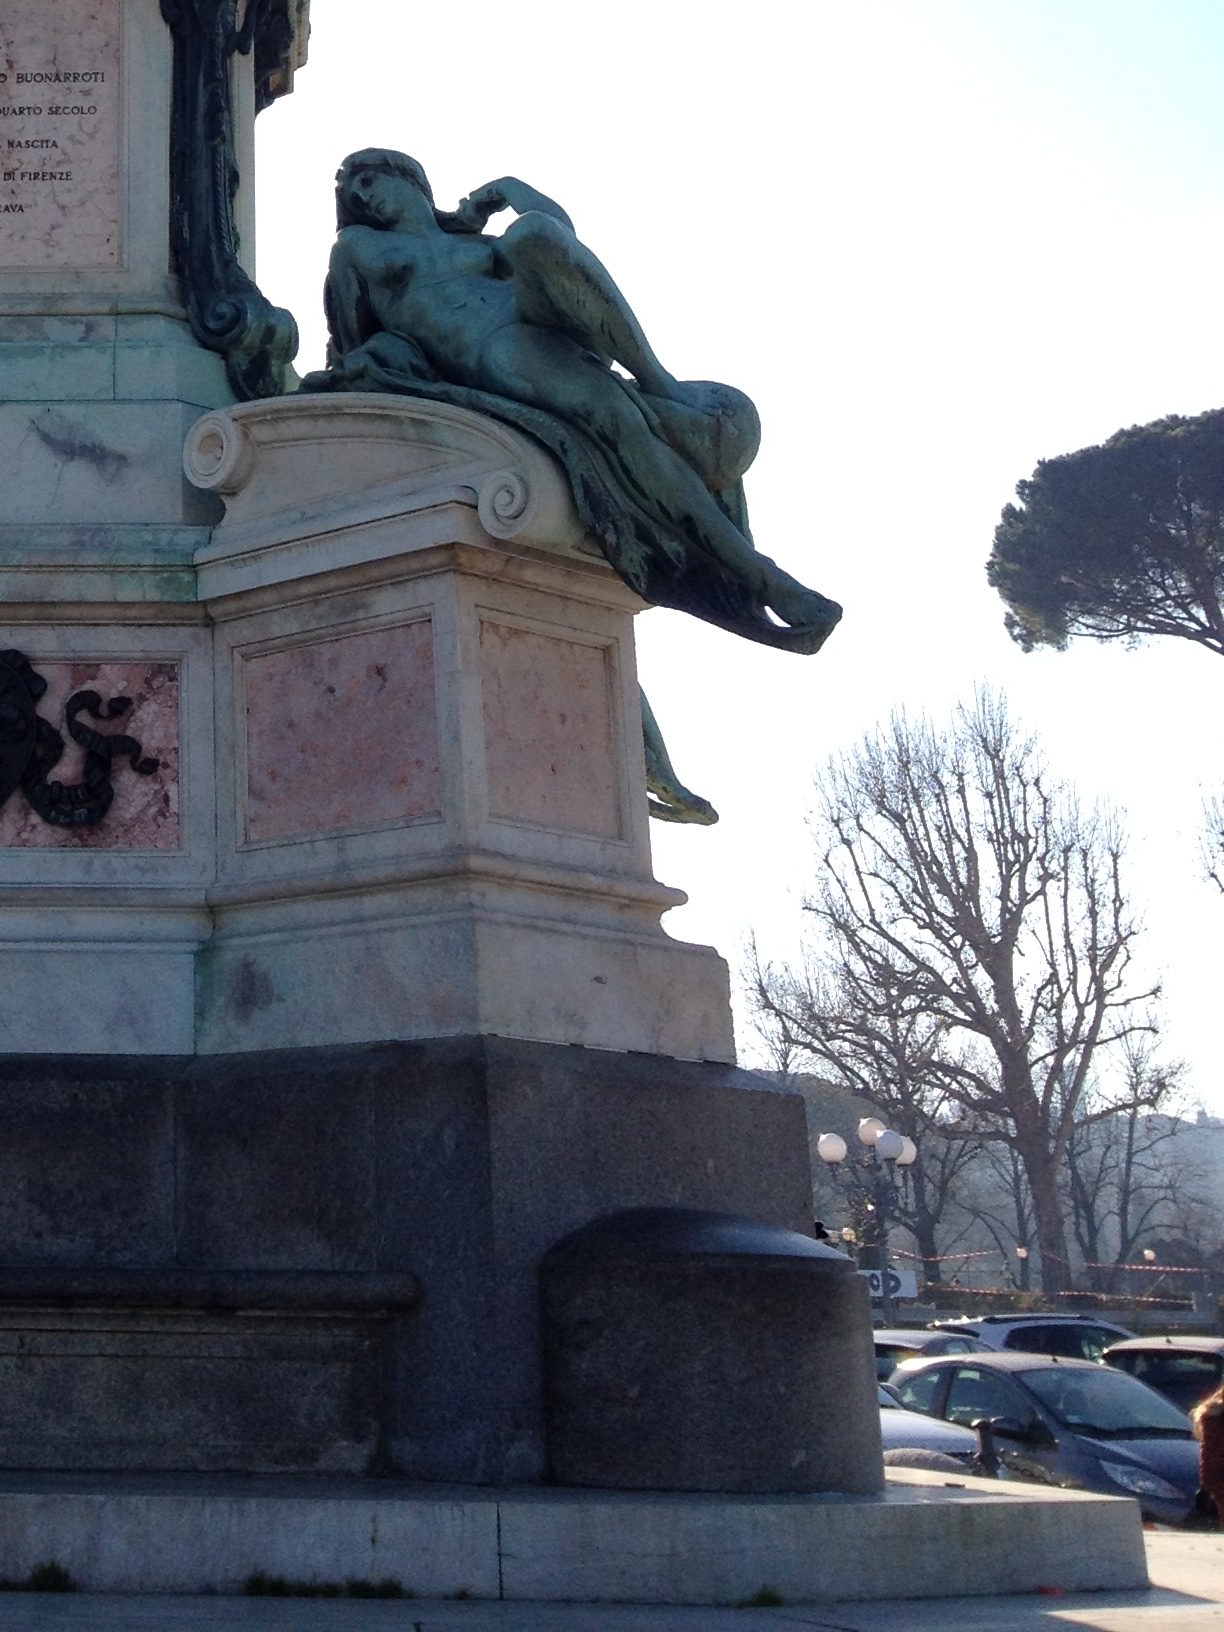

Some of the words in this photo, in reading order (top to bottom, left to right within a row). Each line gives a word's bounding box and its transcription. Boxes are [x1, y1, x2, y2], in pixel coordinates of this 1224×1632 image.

[16, 71, 106, 84] BUONARROTI
[47, 105, 98, 116] SECOLO
[7, 139, 59, 150] NASCITA
[3, 172, 16, 183] DI
[20, 171, 74, 182] FIRENZE
